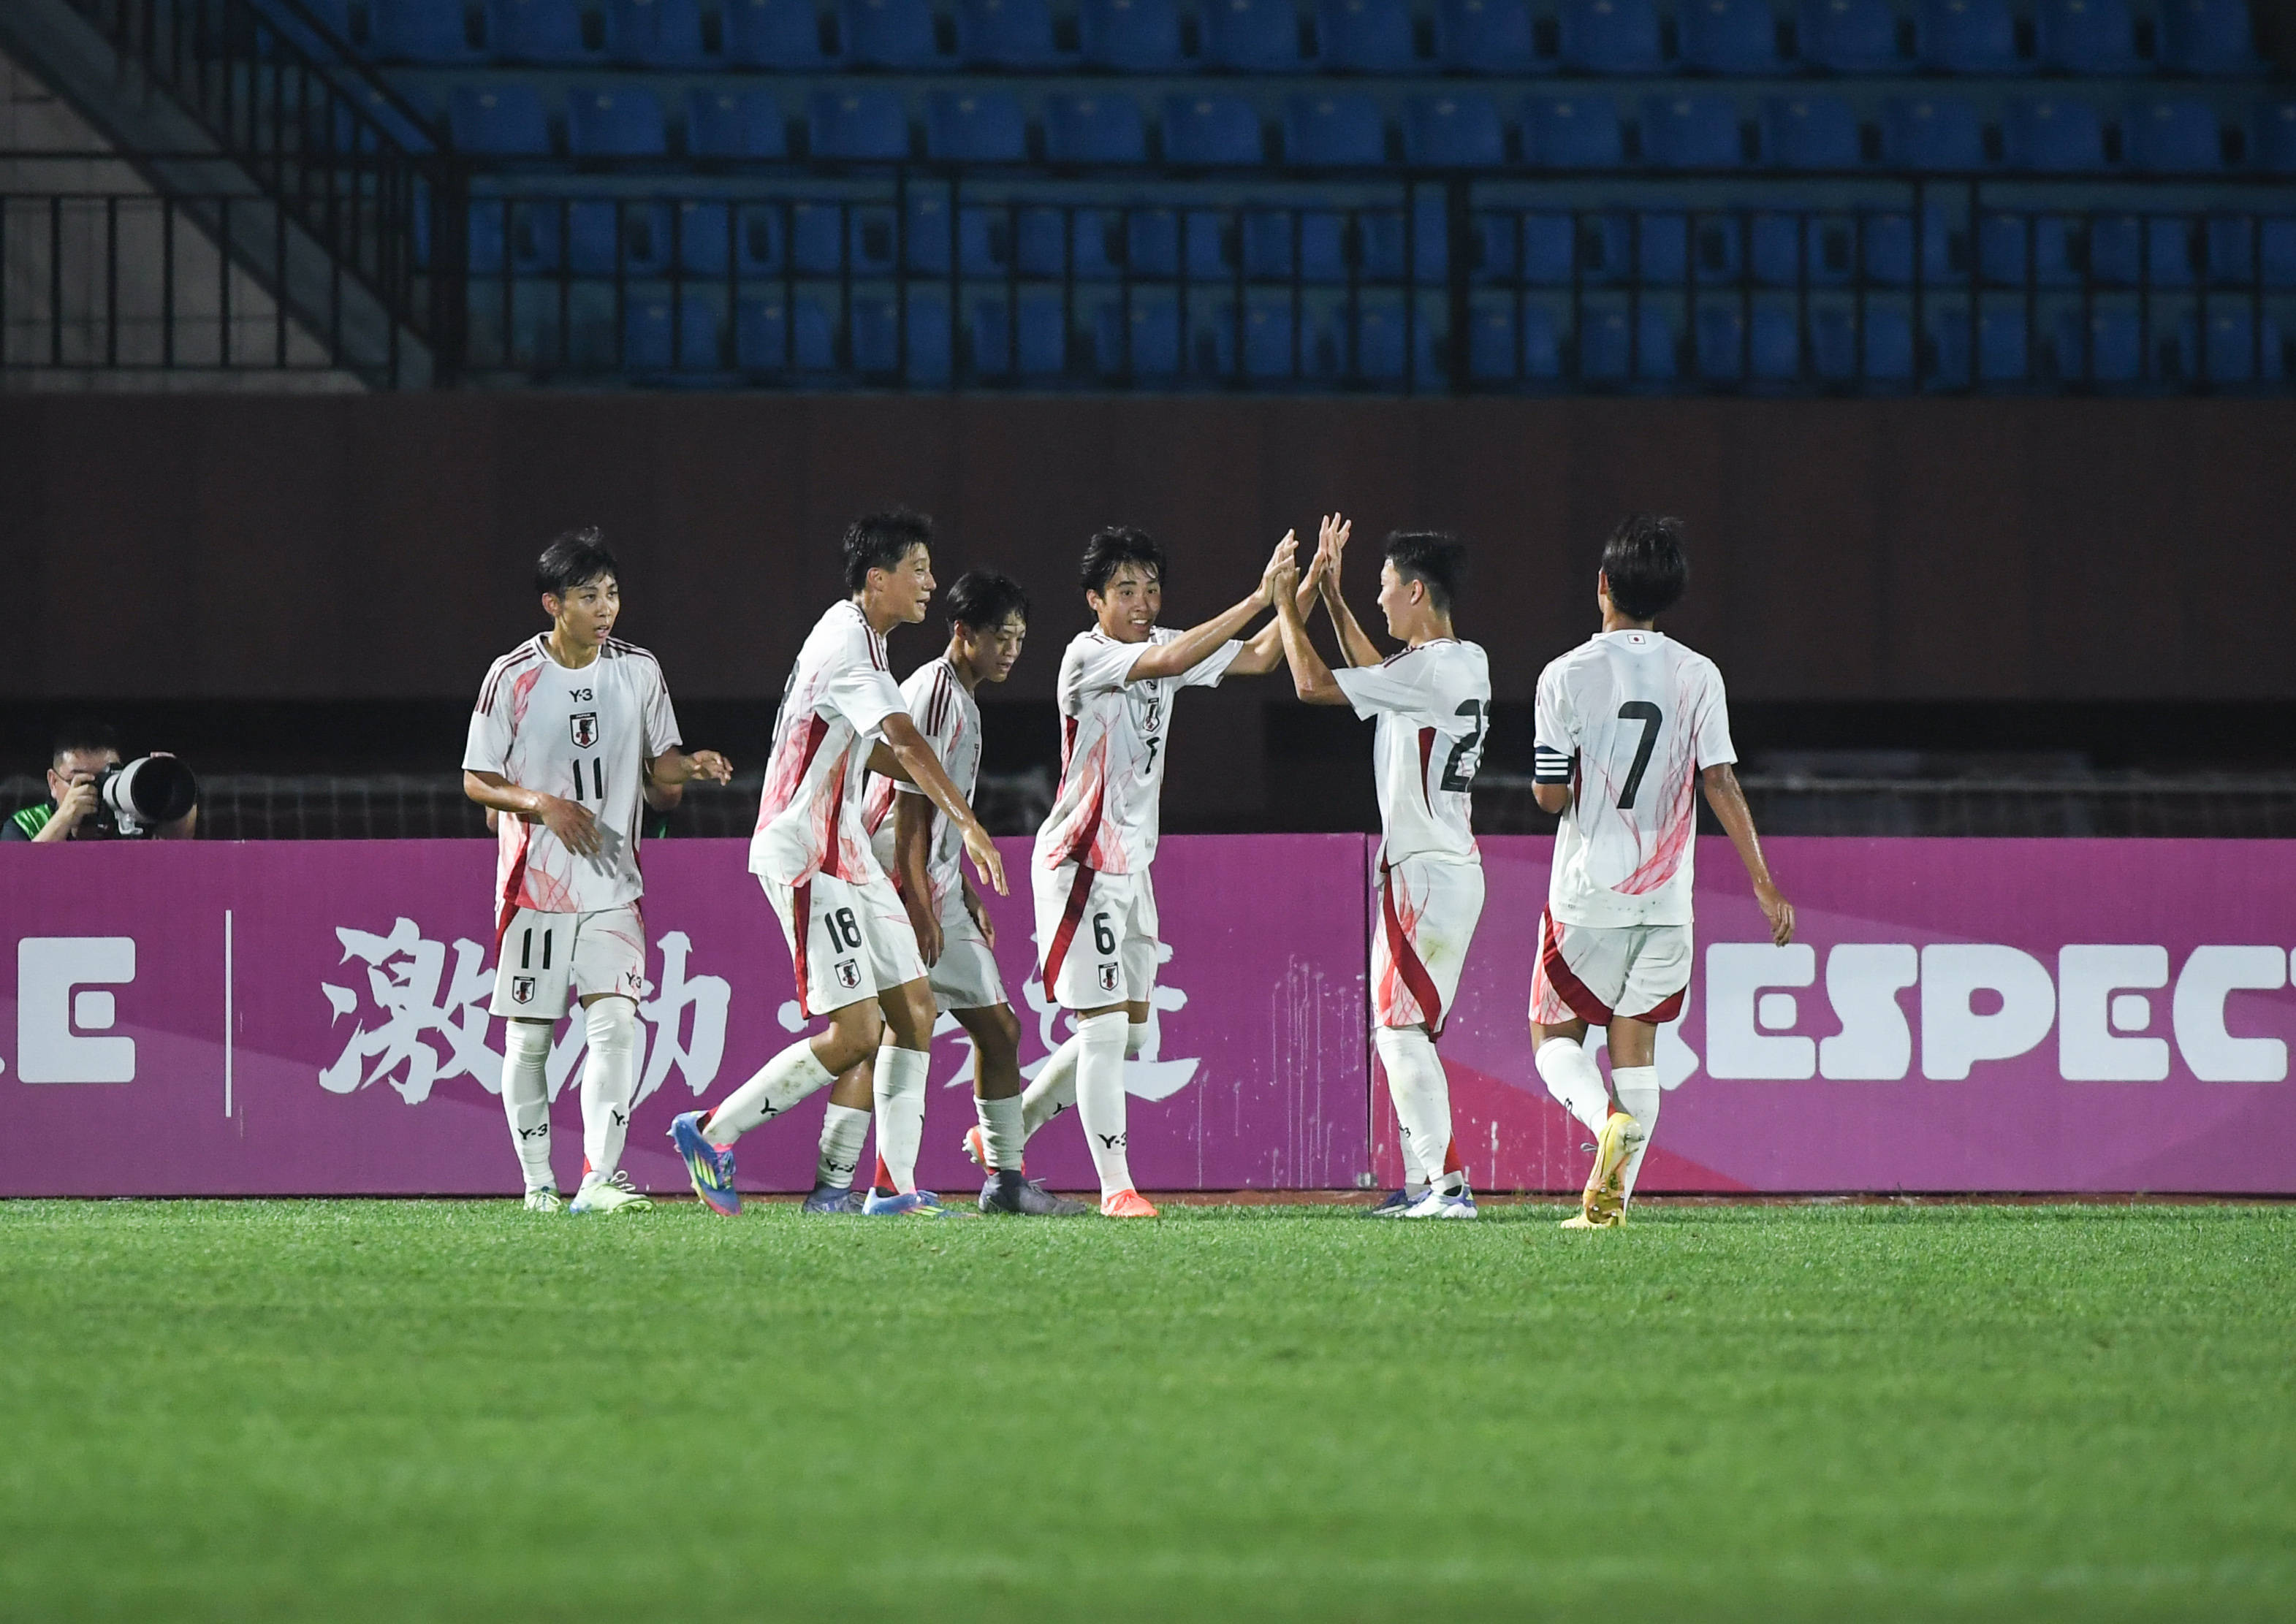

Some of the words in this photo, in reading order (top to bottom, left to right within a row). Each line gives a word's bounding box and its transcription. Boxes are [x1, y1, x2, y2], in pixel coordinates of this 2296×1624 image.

[569, 687, 593, 703] Y-3
[1616, 701, 1663, 809] 7
[573, 757, 603, 801] 11
[521, 928, 552, 970] 11
[824, 906, 862, 954] 18
[1092, 912, 1116, 956] 6
[626, 972, 642, 989] Y-3
[0, 937, 136, 1083] E
[1584, 942, 2296, 1091] ESPEC
[517, 1123, 548, 1140] Y-3
